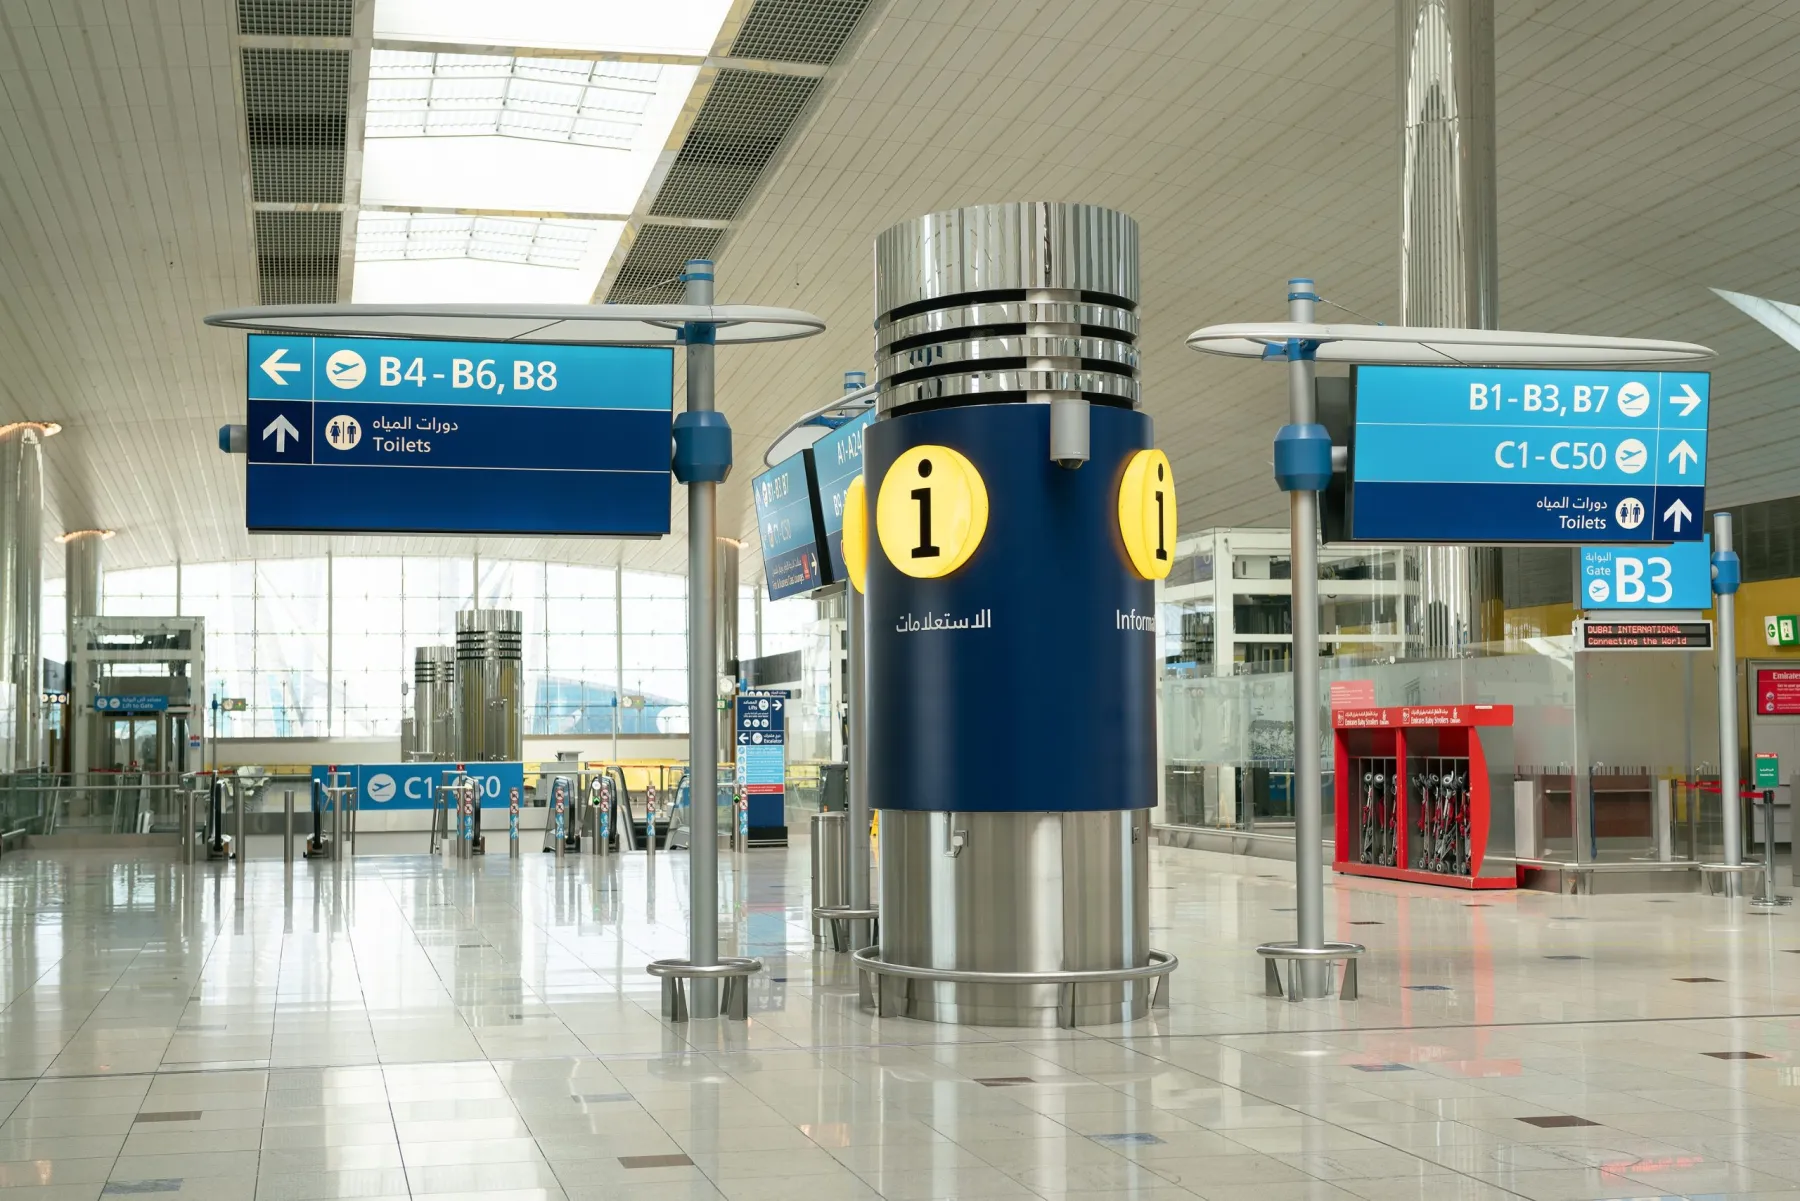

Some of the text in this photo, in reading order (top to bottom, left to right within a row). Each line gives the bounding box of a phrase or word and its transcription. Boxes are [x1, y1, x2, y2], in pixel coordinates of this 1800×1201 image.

[372, 415, 459, 434] دورات المياه
[372, 436, 432, 453] Toilets
[1536, 496, 1608, 512] دورات المياه
[1558, 515, 1607, 530] Toilets
[1585, 551, 1612, 563] البوابة
[1586, 565, 1611, 576] Gate
[1615, 557, 1673, 604] B3
[895, 608, 992, 634] الاستعلامات
[1587, 625, 1682, 634] DUBAI INTERNATIONAL
[1588, 637, 1687, 646] Connecting the World
